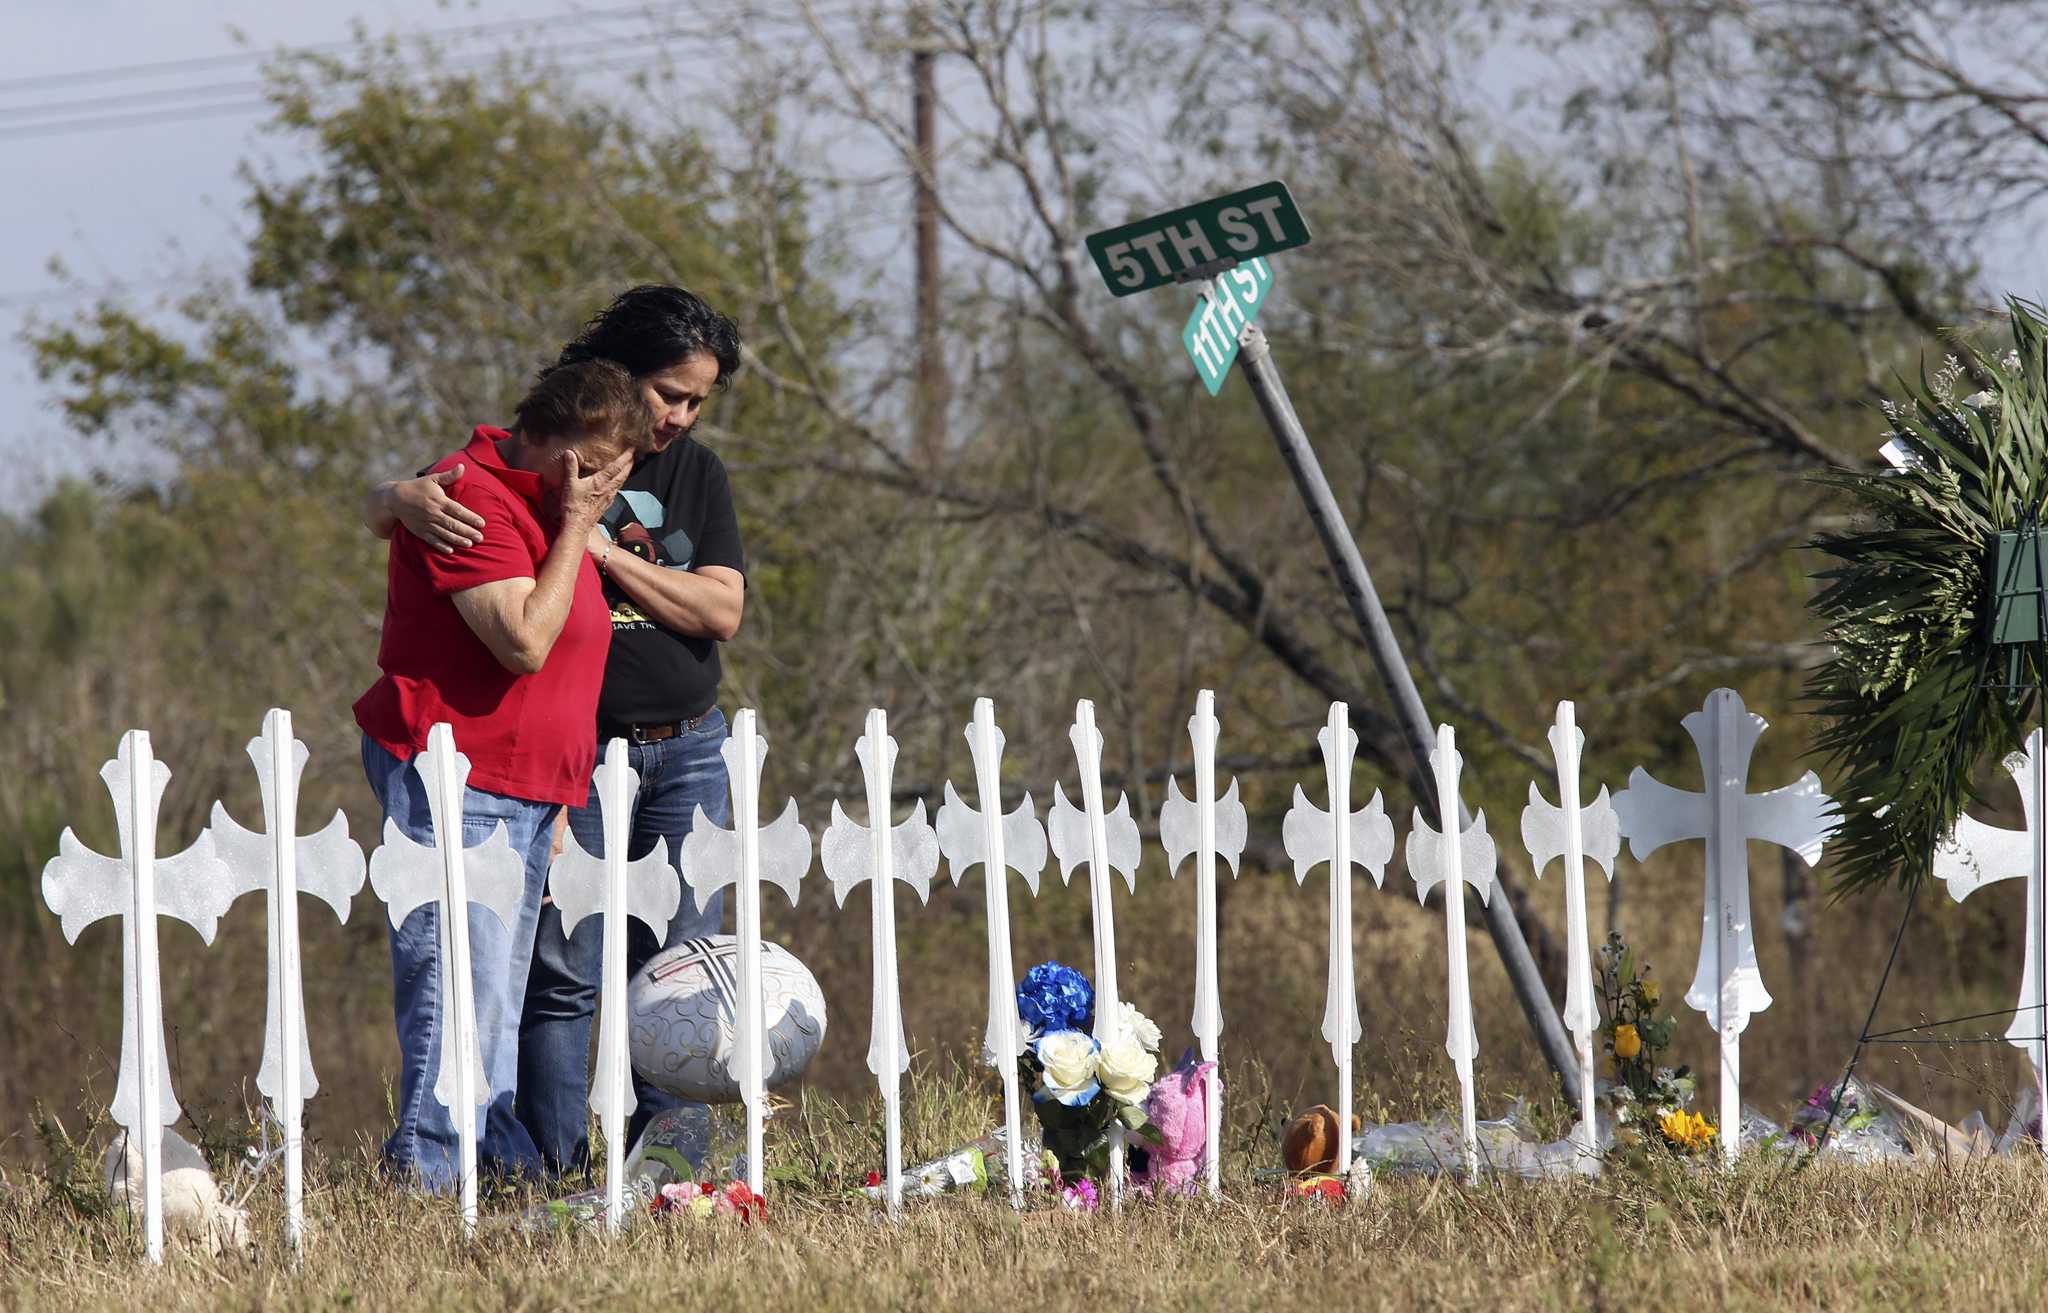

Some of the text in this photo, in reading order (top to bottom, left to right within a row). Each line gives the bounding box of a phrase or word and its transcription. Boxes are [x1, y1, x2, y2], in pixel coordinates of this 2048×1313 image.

[1104, 196, 1287, 287] 5TH ST
[1193, 272, 1245, 379] 11TH
[640, 622, 657, 630] TH
